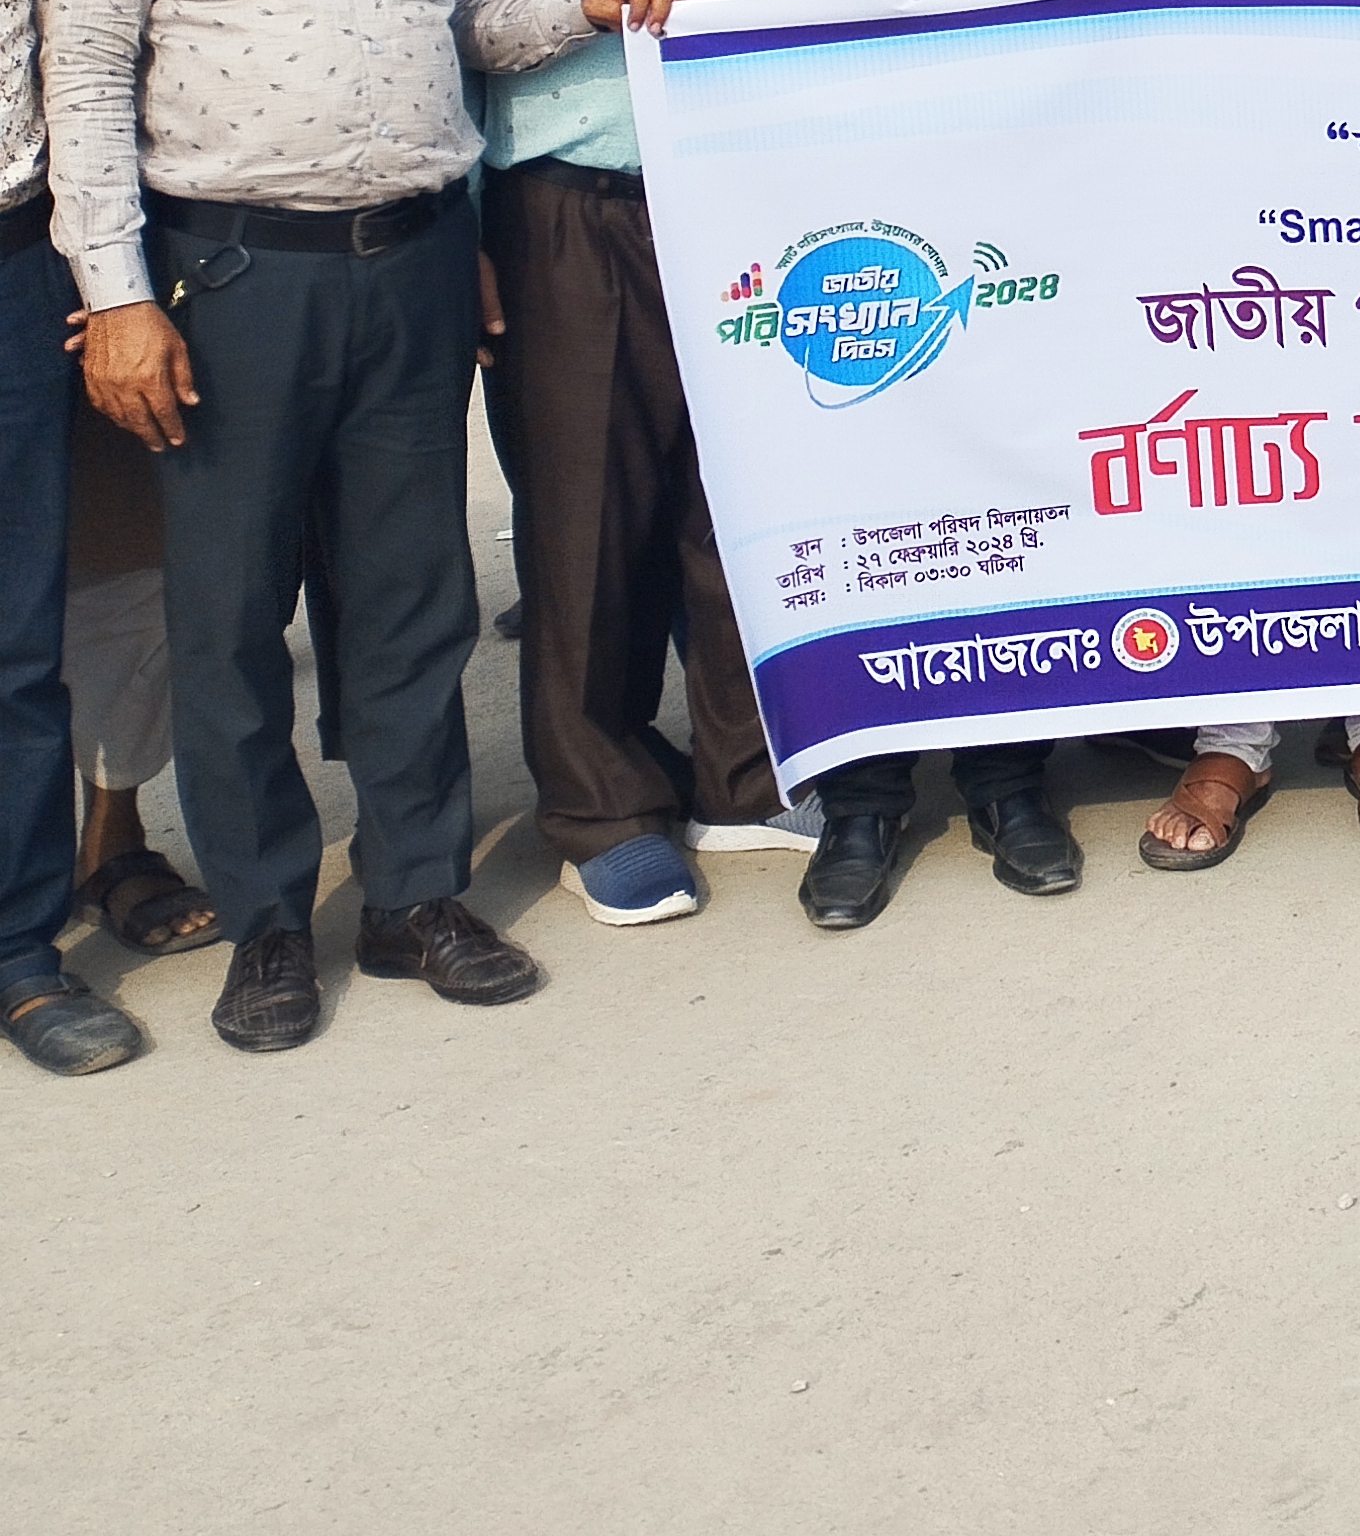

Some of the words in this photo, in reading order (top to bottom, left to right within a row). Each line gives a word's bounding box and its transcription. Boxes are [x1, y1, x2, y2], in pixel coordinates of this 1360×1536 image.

[822, 265, 901, 295] জাতীয়
[975, 273, 1060, 309] ২০২৪
[1136, 265, 1335, 351] জাতীয়
[831, 336, 898, 363] দিবস
[1078, 389, 1328, 516] বর্ণাঢ্য
[789, 537, 823, 561] স্থান
[852, 522, 923, 547] উপজেলা
[929, 514, 981, 537] পরিষদ
[987, 505, 1071, 530] মিলনায়তন
[775, 564, 826, 589] তারিখ
[857, 552, 882, 570] ২৭
[889, 537, 960, 565] ফেব্রুয়ারি
[966, 534, 1013, 555] ২০২৪
[857, 570, 908, 593] বিকাল
[914, 565, 971, 584] ০৩:৩০
[976, 554, 1025, 576] ঘটিকা
